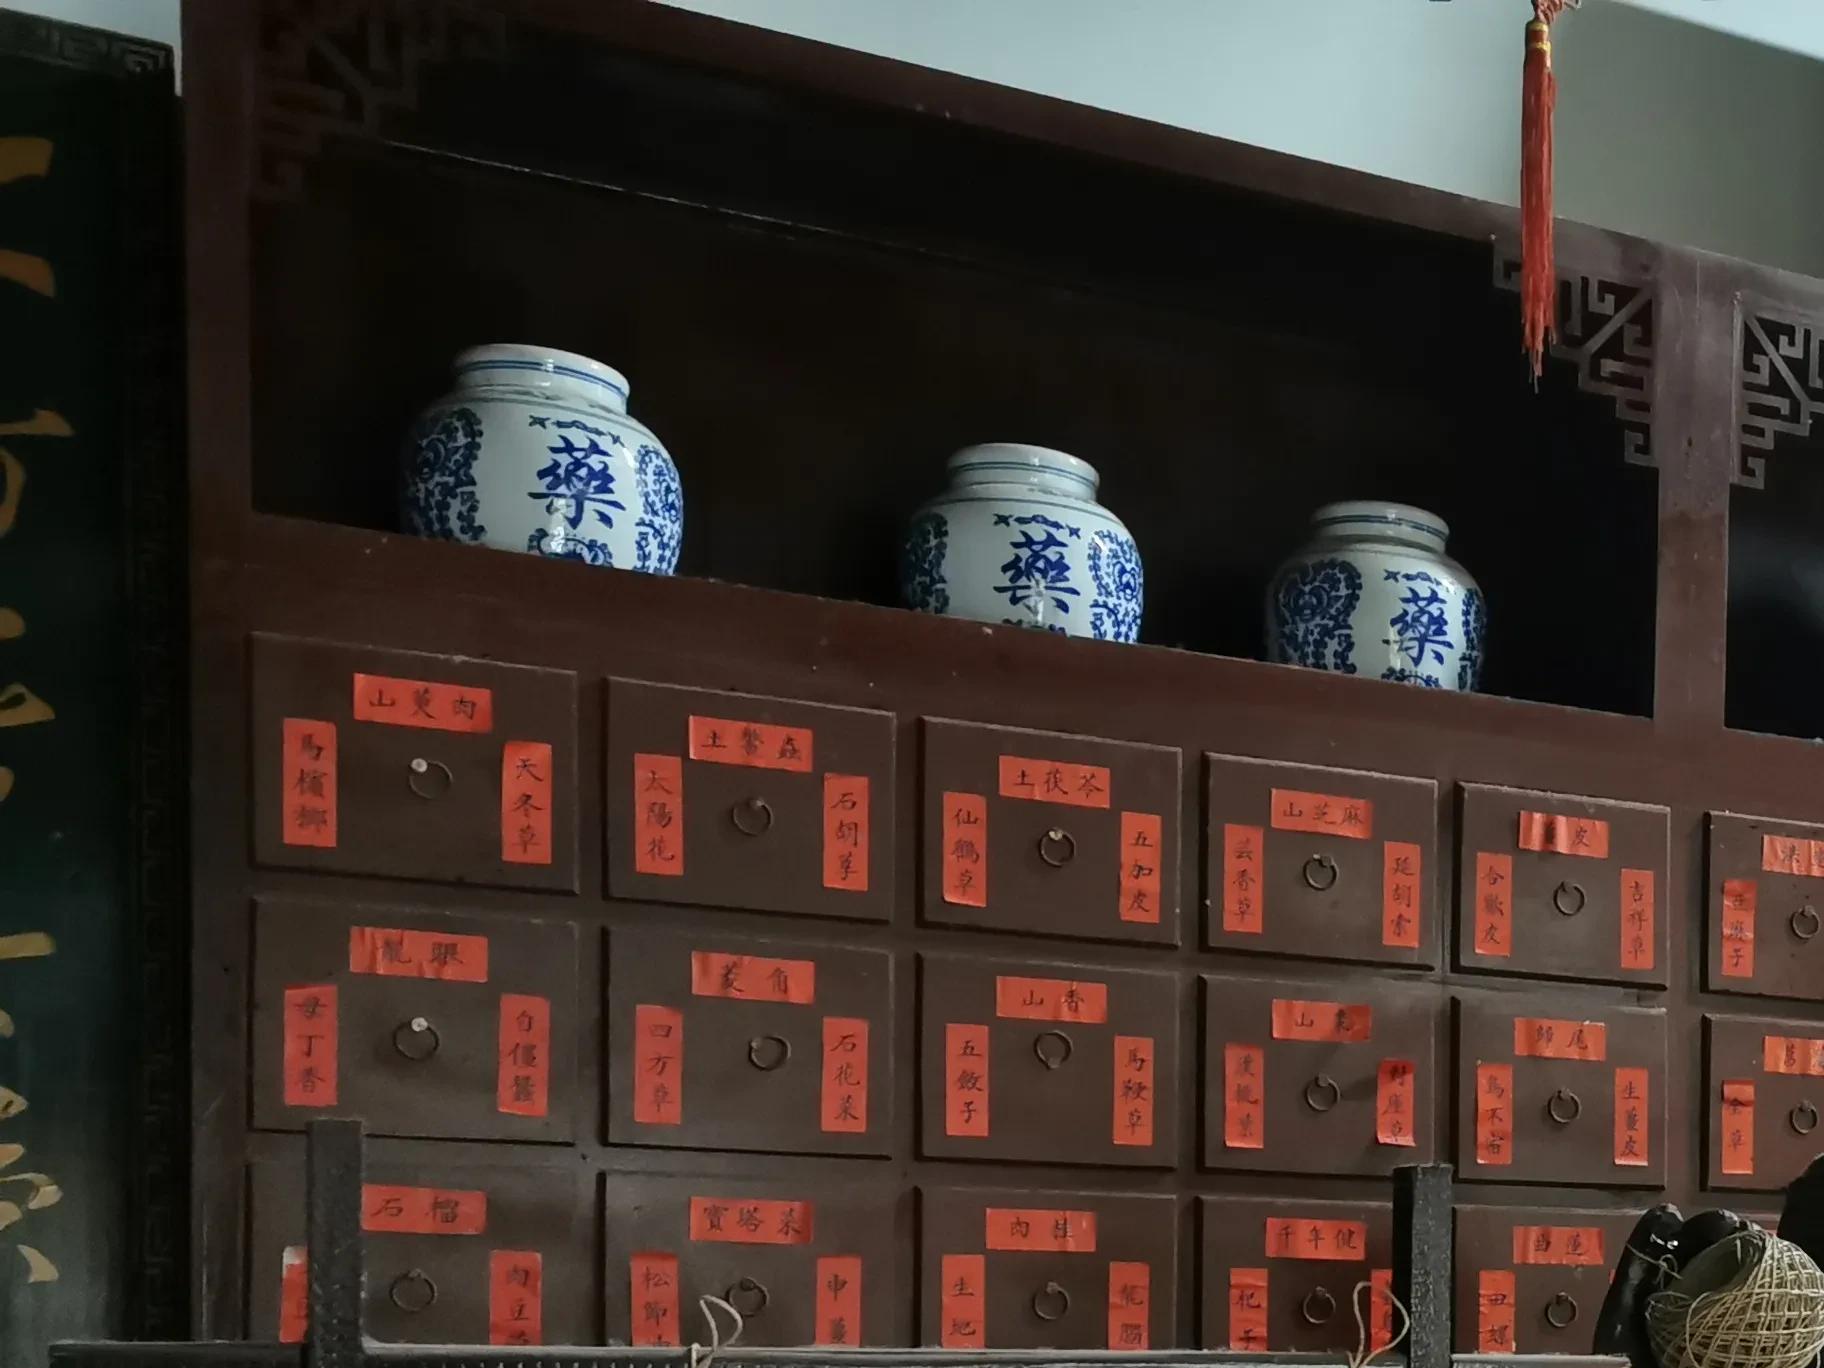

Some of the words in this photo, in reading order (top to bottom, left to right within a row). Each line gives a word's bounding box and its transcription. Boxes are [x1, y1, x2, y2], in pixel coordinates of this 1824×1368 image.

[527, 434, 626, 531] 藥
[993, 529, 1081, 615] 藥
[1381, 586, 1457, 671] 藥
[1014, 768, 1108, 801] 土茯苓
[1129, 829, 1156, 916] 五加皮
[1122, 1046, 1150, 1132] 馬鞭草
[1280, 1224, 1361, 1252] 千年健
